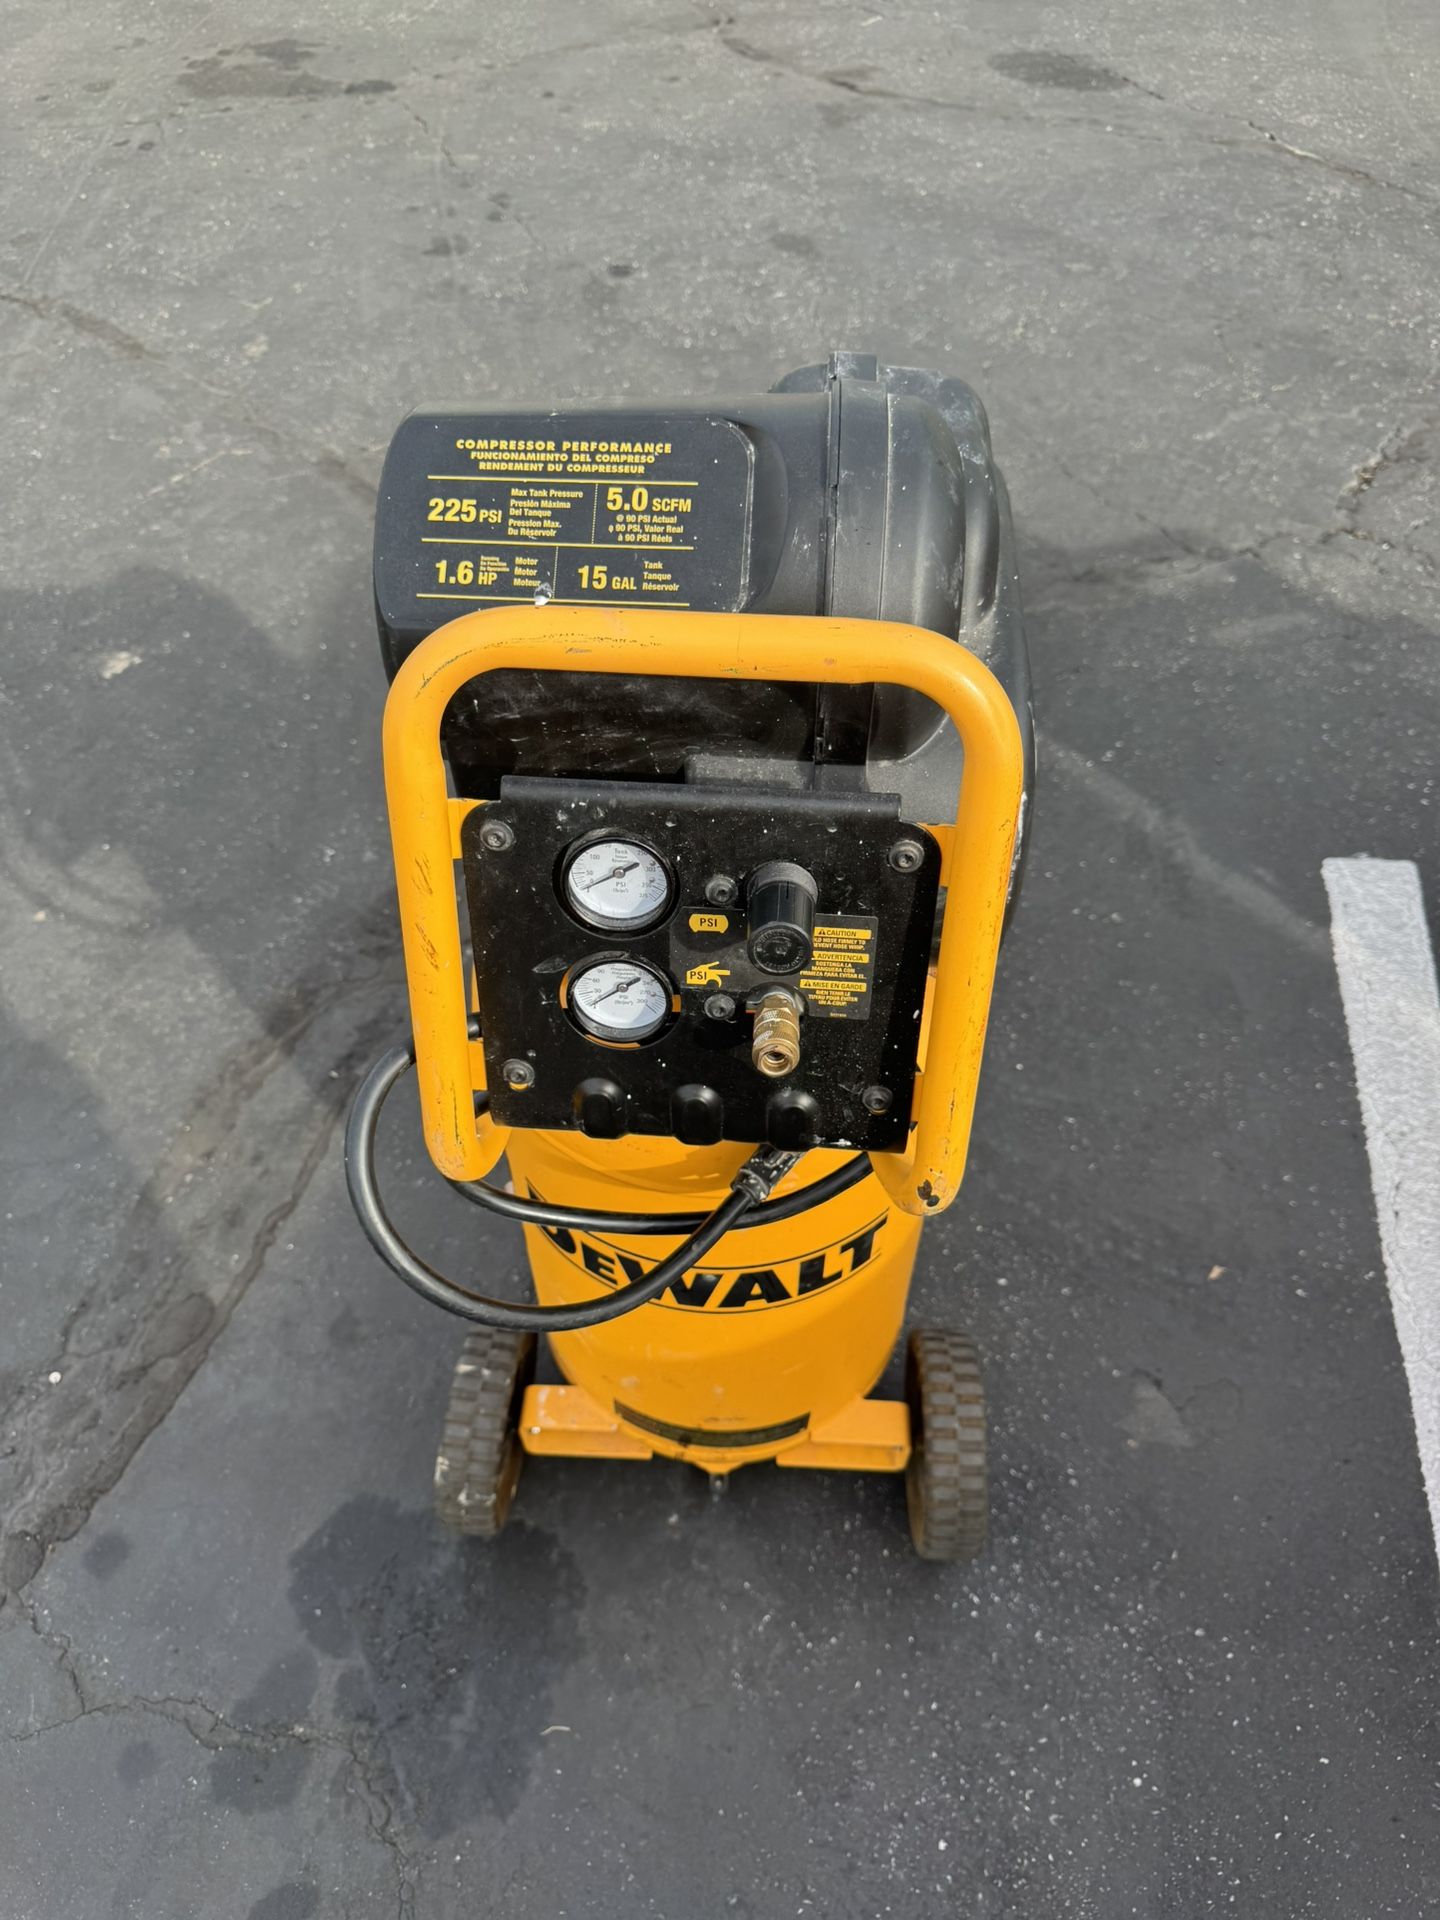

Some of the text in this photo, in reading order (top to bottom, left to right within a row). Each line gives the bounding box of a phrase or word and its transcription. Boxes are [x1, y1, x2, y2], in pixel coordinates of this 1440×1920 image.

[456, 440, 672, 453] COMPRESSOR PERFORMANCE
[471, 451, 568, 461] FUNCIONAMIENTO
[572, 453, 591, 462] DEL
[480, 462, 644, 473] RENDEMENT DU COMPRESSEUR
[511, 488, 583, 498] Max Tank Pressure
[510, 499, 570, 508] Presión Máxima
[607, 487, 691, 512] 5.0 SCFM
[428, 498, 502, 523] 225 PSI
[510, 508, 552, 517] Del Tanque
[509, 518, 562, 528] Pression Max.
[638, 515, 650, 523] PSI
[652, 515, 677, 524] Actual
[520, 528, 556, 537] Réservoir
[616, 524, 625, 532] 90
[627, 525, 642, 533] PSI,
[644, 525, 664, 533] Valor
[666, 525, 684, 533] Real
[625, 534, 635, 542] 90
[637, 534, 649, 542] PSI
[515, 557, 538, 565] Motor
[644, 561, 663, 569] Tank
[435, 560, 474, 584] 1.6
[478, 572, 497, 585] HP
[514, 566, 537, 576] Motor
[578, 565, 637, 590] 15 GAL
[643, 572, 671, 581] Tanque
[513, 578, 541, 587] Moteur
[642, 582, 679, 591] Réservoir
[700, 918, 717, 927] PSI
[818, 953, 863, 961] ADVERTENCIA
[690, 971, 707, 980] PSI
